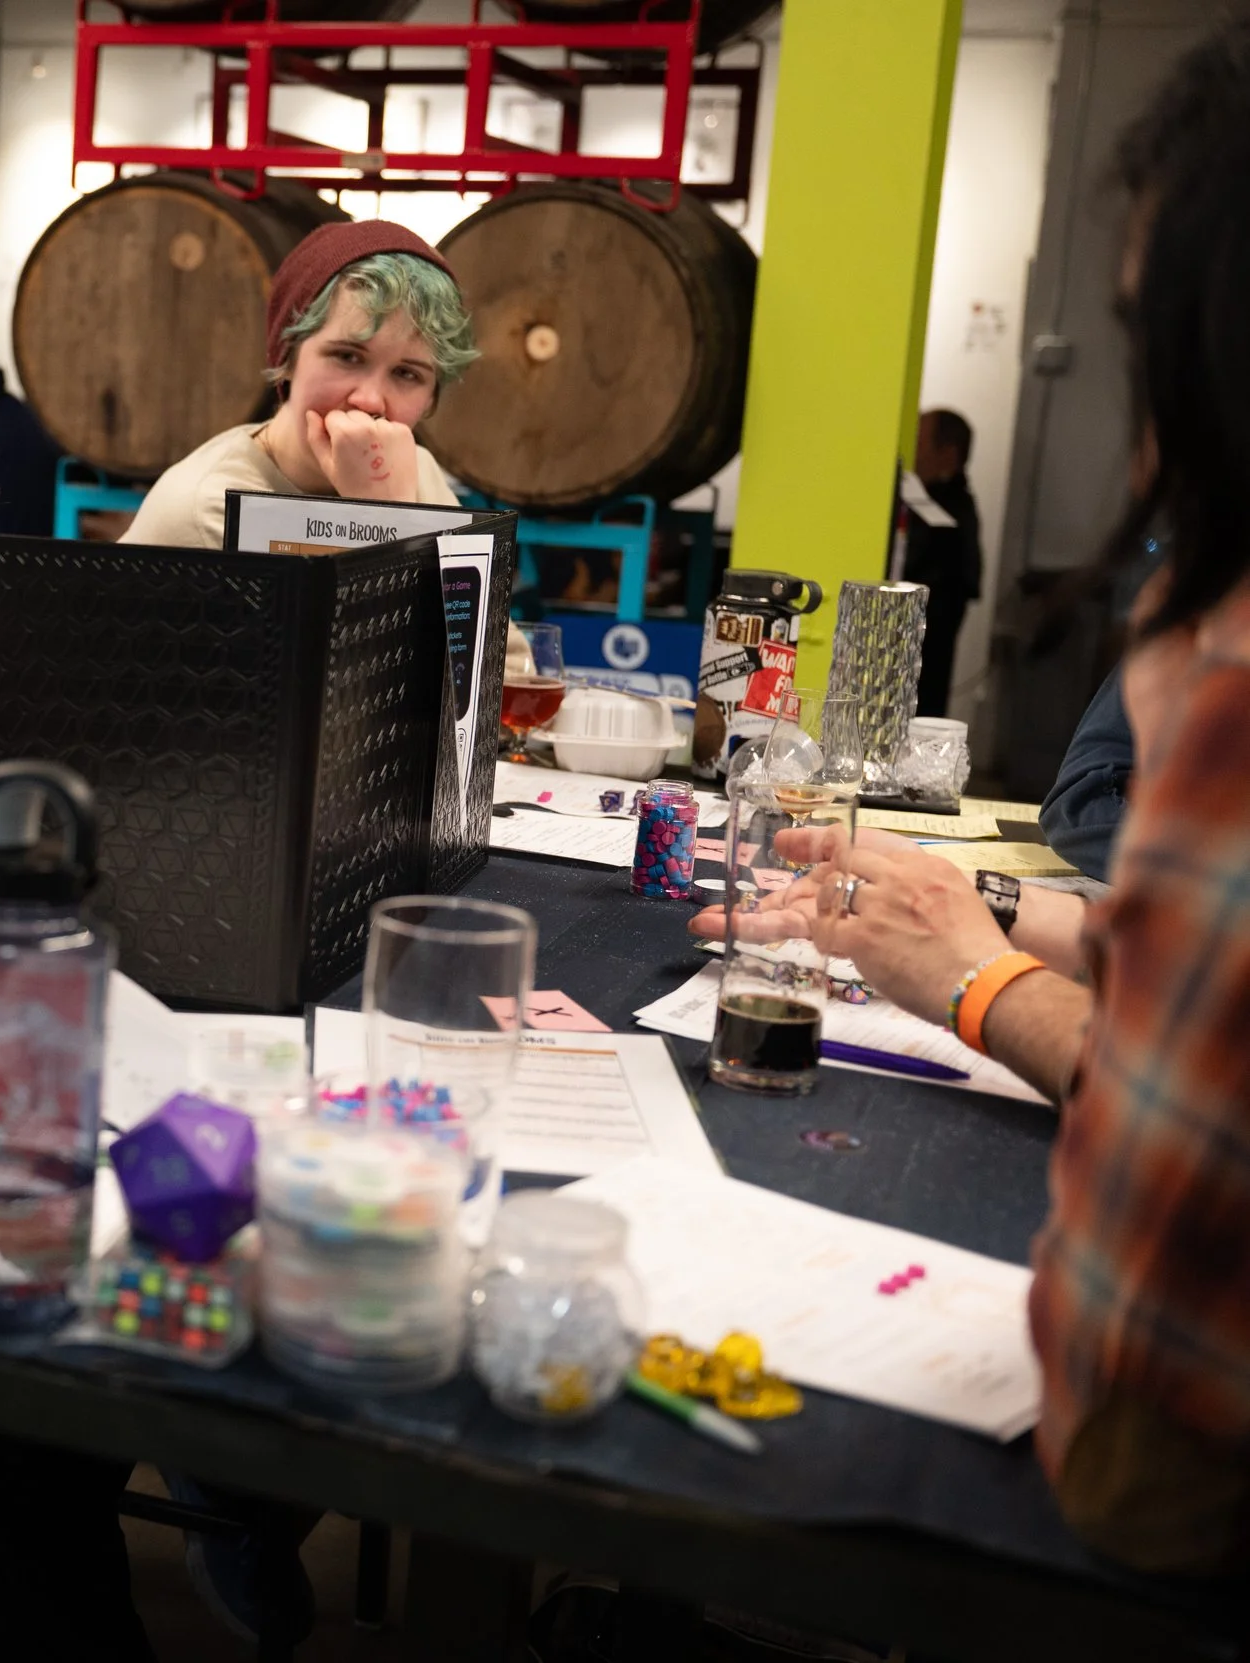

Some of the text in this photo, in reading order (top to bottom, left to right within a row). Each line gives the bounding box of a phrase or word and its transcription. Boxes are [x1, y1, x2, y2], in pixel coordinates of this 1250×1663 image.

[306, 517, 333, 539] KIDS
[349, 520, 398, 543] BROOMS
[277, 543, 292, 552] STAT
[456, 581, 471, 590] Game
